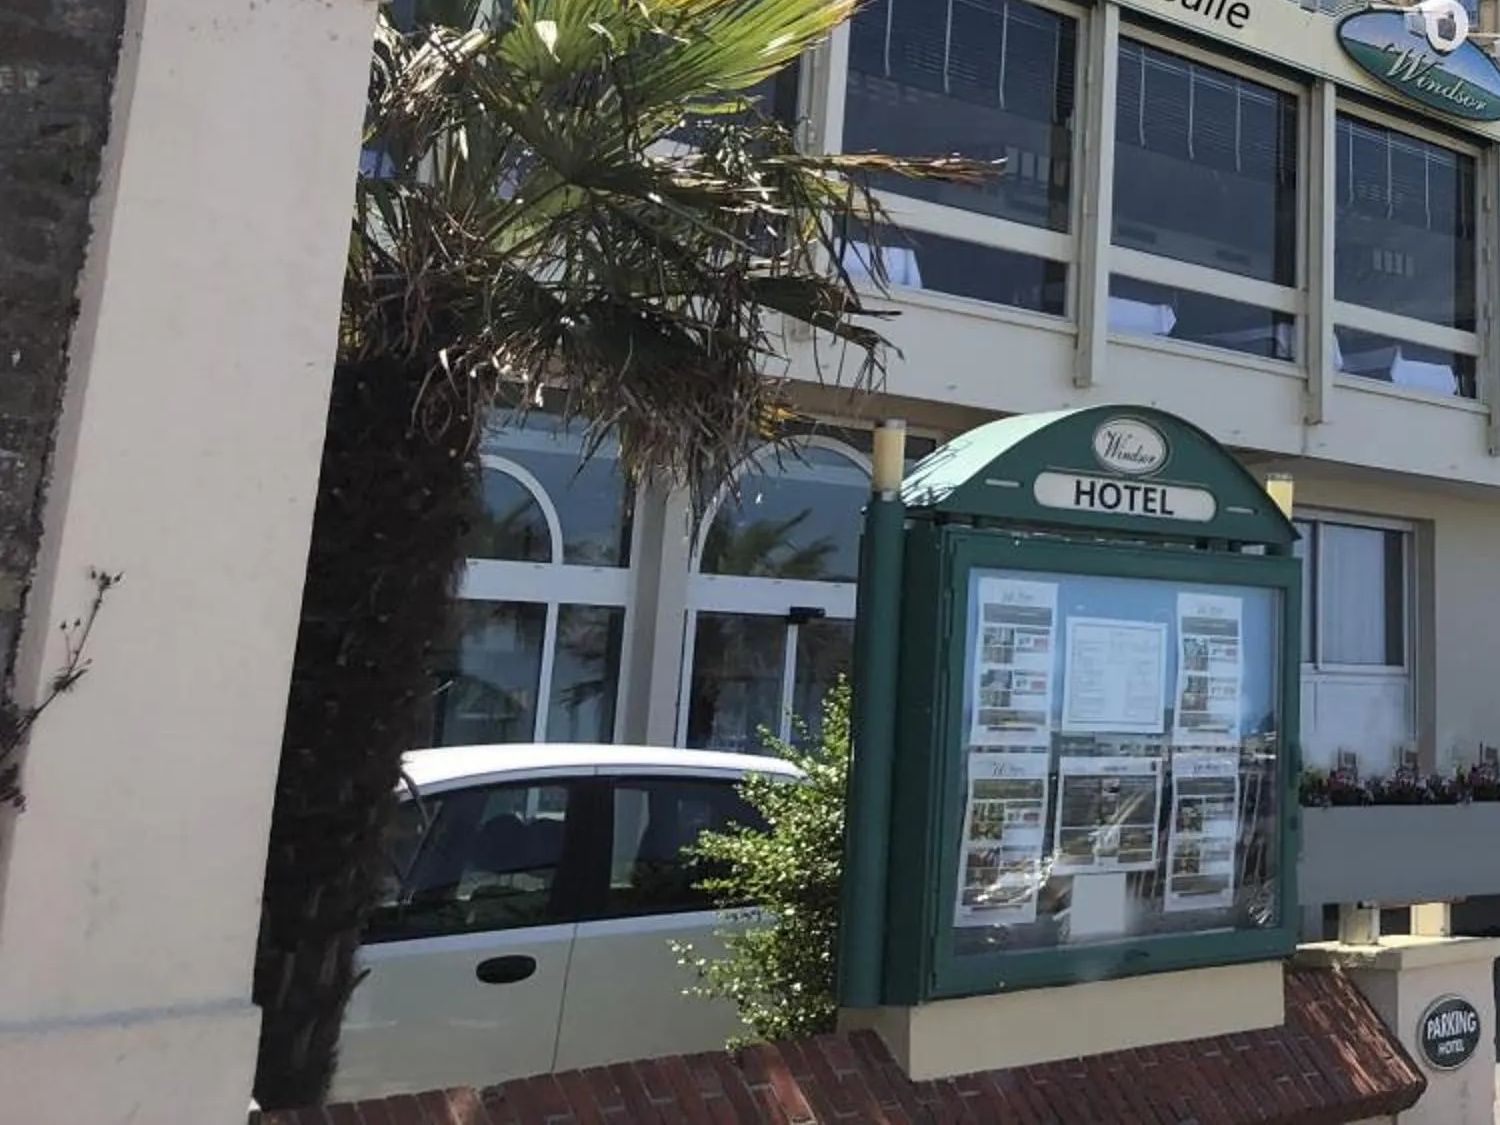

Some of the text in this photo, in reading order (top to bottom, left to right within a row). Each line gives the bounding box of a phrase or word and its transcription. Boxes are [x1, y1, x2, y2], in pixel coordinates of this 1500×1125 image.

[1382, 42, 1487, 111] Windsor
[1102, 430, 1157, 464] Windsor
[1074, 479, 1175, 516] HOTEL
[1427, 1010, 1478, 1039] PARKING
